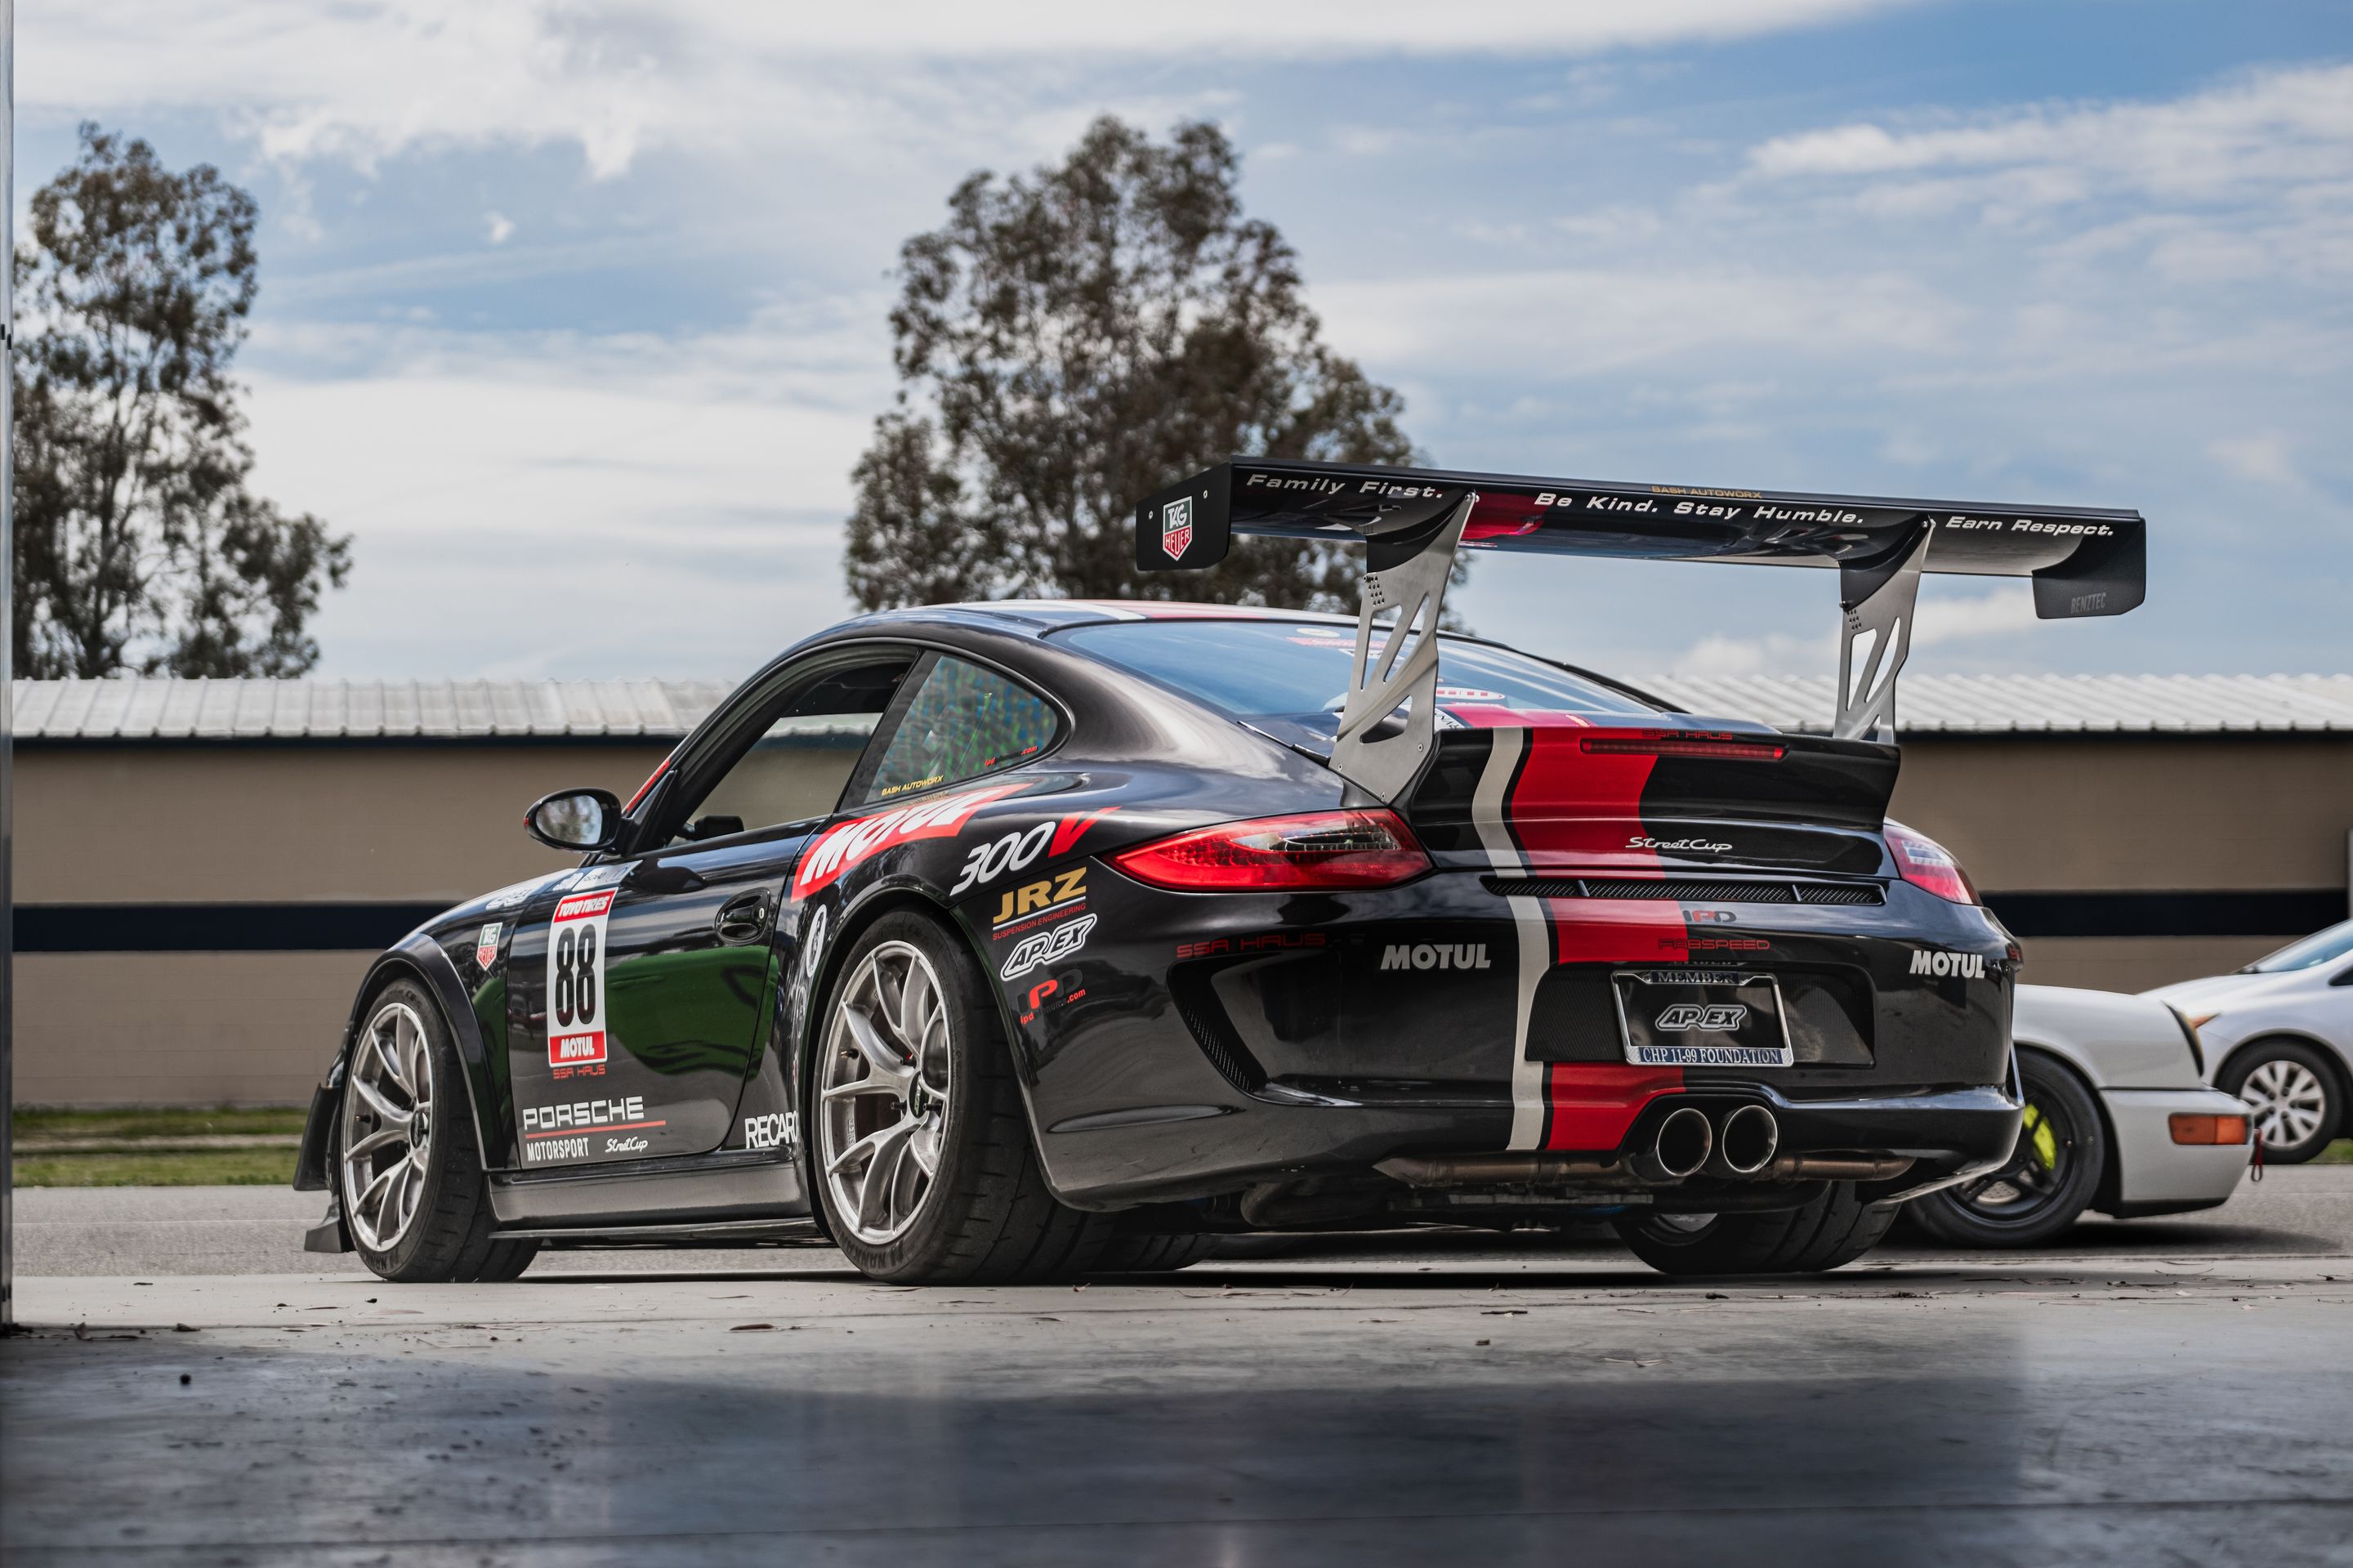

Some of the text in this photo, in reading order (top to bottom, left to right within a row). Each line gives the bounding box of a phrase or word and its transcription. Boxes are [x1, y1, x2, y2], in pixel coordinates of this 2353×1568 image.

[1246, 473, 1444, 499] Family First.
[1650, 485, 1763, 499] BASH AUTOWORX
[1168, 503, 1188, 529] TAG
[1534, 492, 1864, 525] Be Kind. Stay Humble.
[1944, 516, 2114, 536] Earn Respect.
[1165, 529, 1190, 556] HEUER
[2070, 592, 2107, 614] BENZTEC
[881, 775, 944, 797] BASH AUTOWORX
[558, 896, 611, 918] TOYO TIRES
[993, 866, 1087, 925] JRZ
[993, 902, 1087, 941] SUSPENSION ENGINEERING
[1682, 909, 1738, 923] IPD
[478, 945, 497, 967] HEUER
[1005, 915, 1095, 976] APEX
[1176, 931, 1326, 958] SSA HAUS
[1379, 943, 1492, 971] MOTUL
[1658, 938, 1770, 951] FABSPEED
[555, 922, 597, 1029] 88
[1909, 949, 1986, 980] MOTUL
[1657, 971, 1735, 984] MEMBER
[1659, 1007, 1743, 1029] APEX
[560, 1035, 596, 1060] MOTUL
[1642, 1048, 1779, 1065] CHP 11-99 FOUNDATION
[552, 1063, 606, 1079] SSA HAUS
[522, 1095, 645, 1131] PORSCHE
[744, 1110, 799, 1150] RECARO
[526, 1137, 590, 1162] MOTORSPORT
